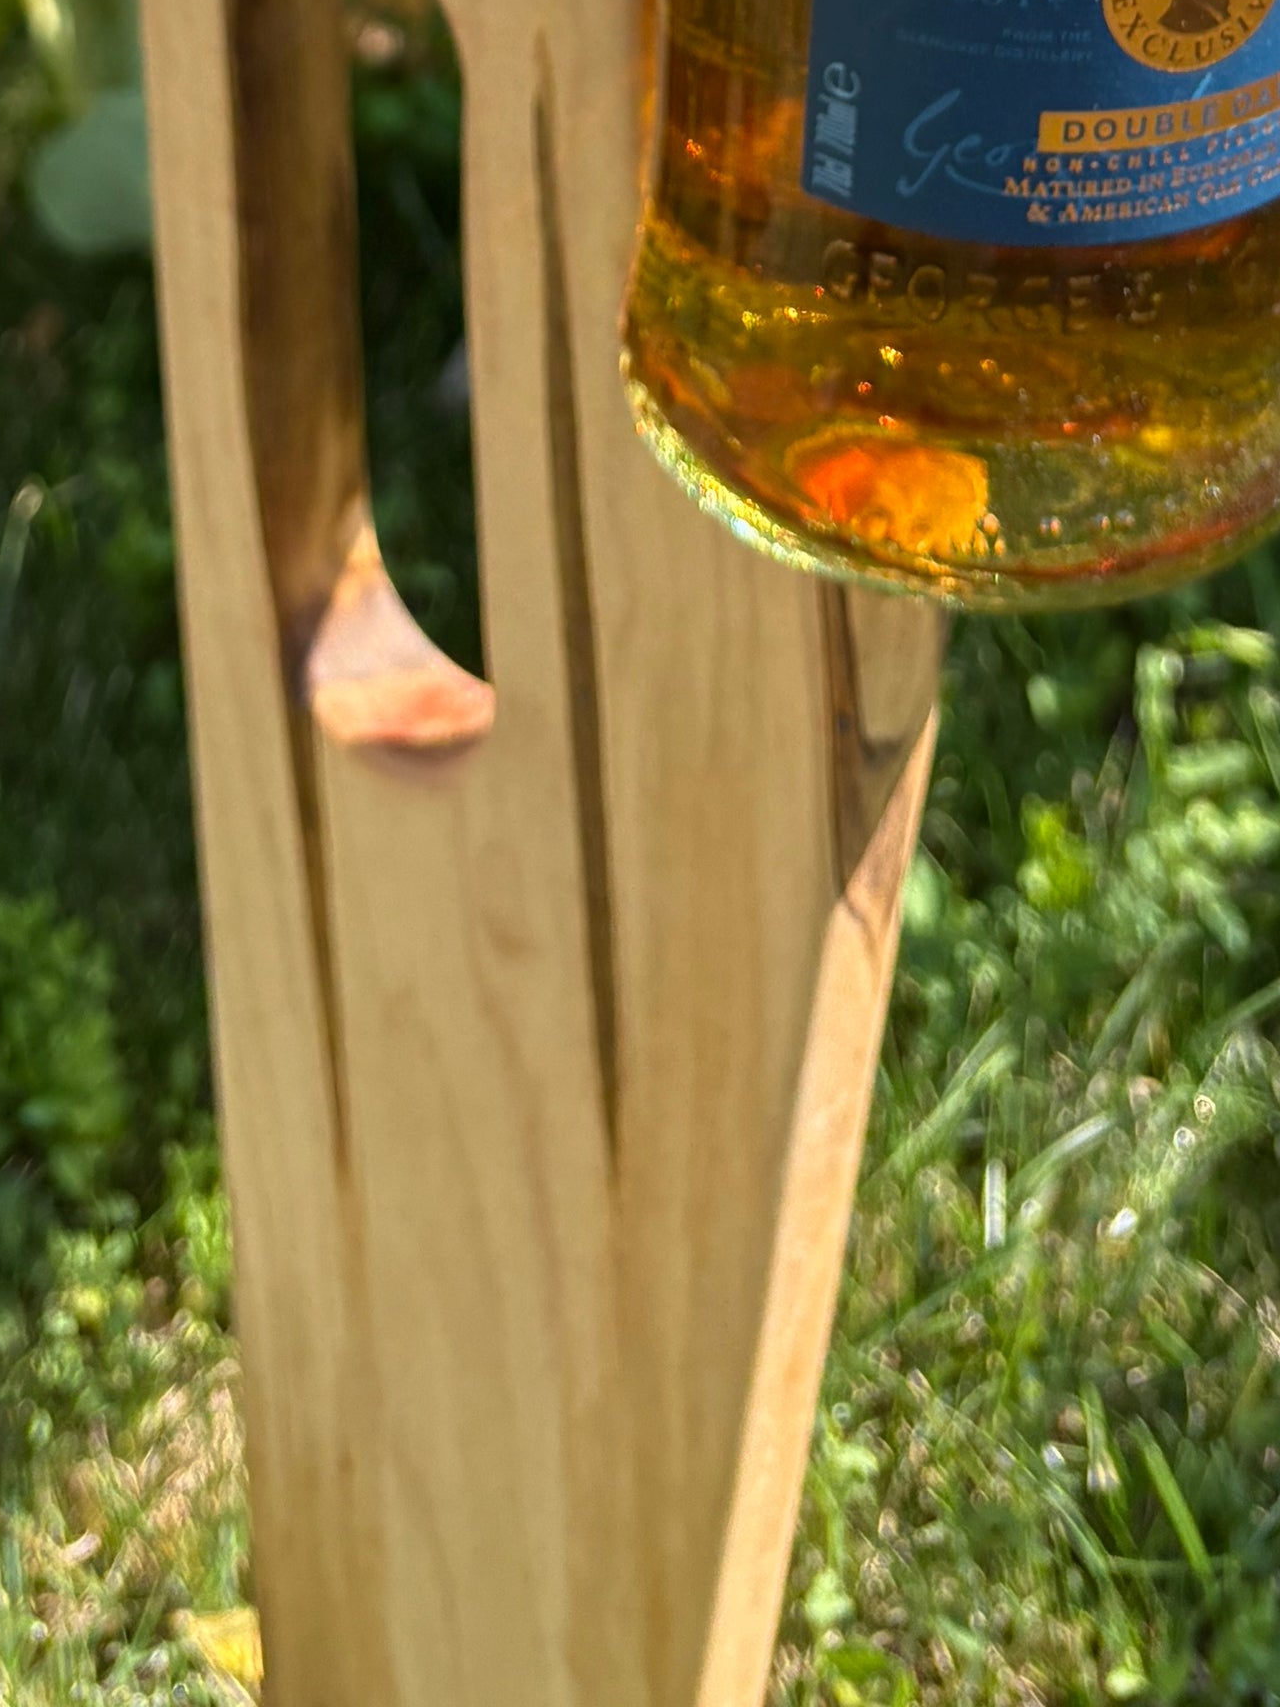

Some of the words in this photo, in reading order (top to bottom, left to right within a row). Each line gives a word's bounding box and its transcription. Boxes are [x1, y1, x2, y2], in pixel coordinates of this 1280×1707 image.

[1062, 102, 1219, 144] DOUBLE
[1026, 201, 1051, 223] &
[1057, 192, 1190, 223] AMERICAN
